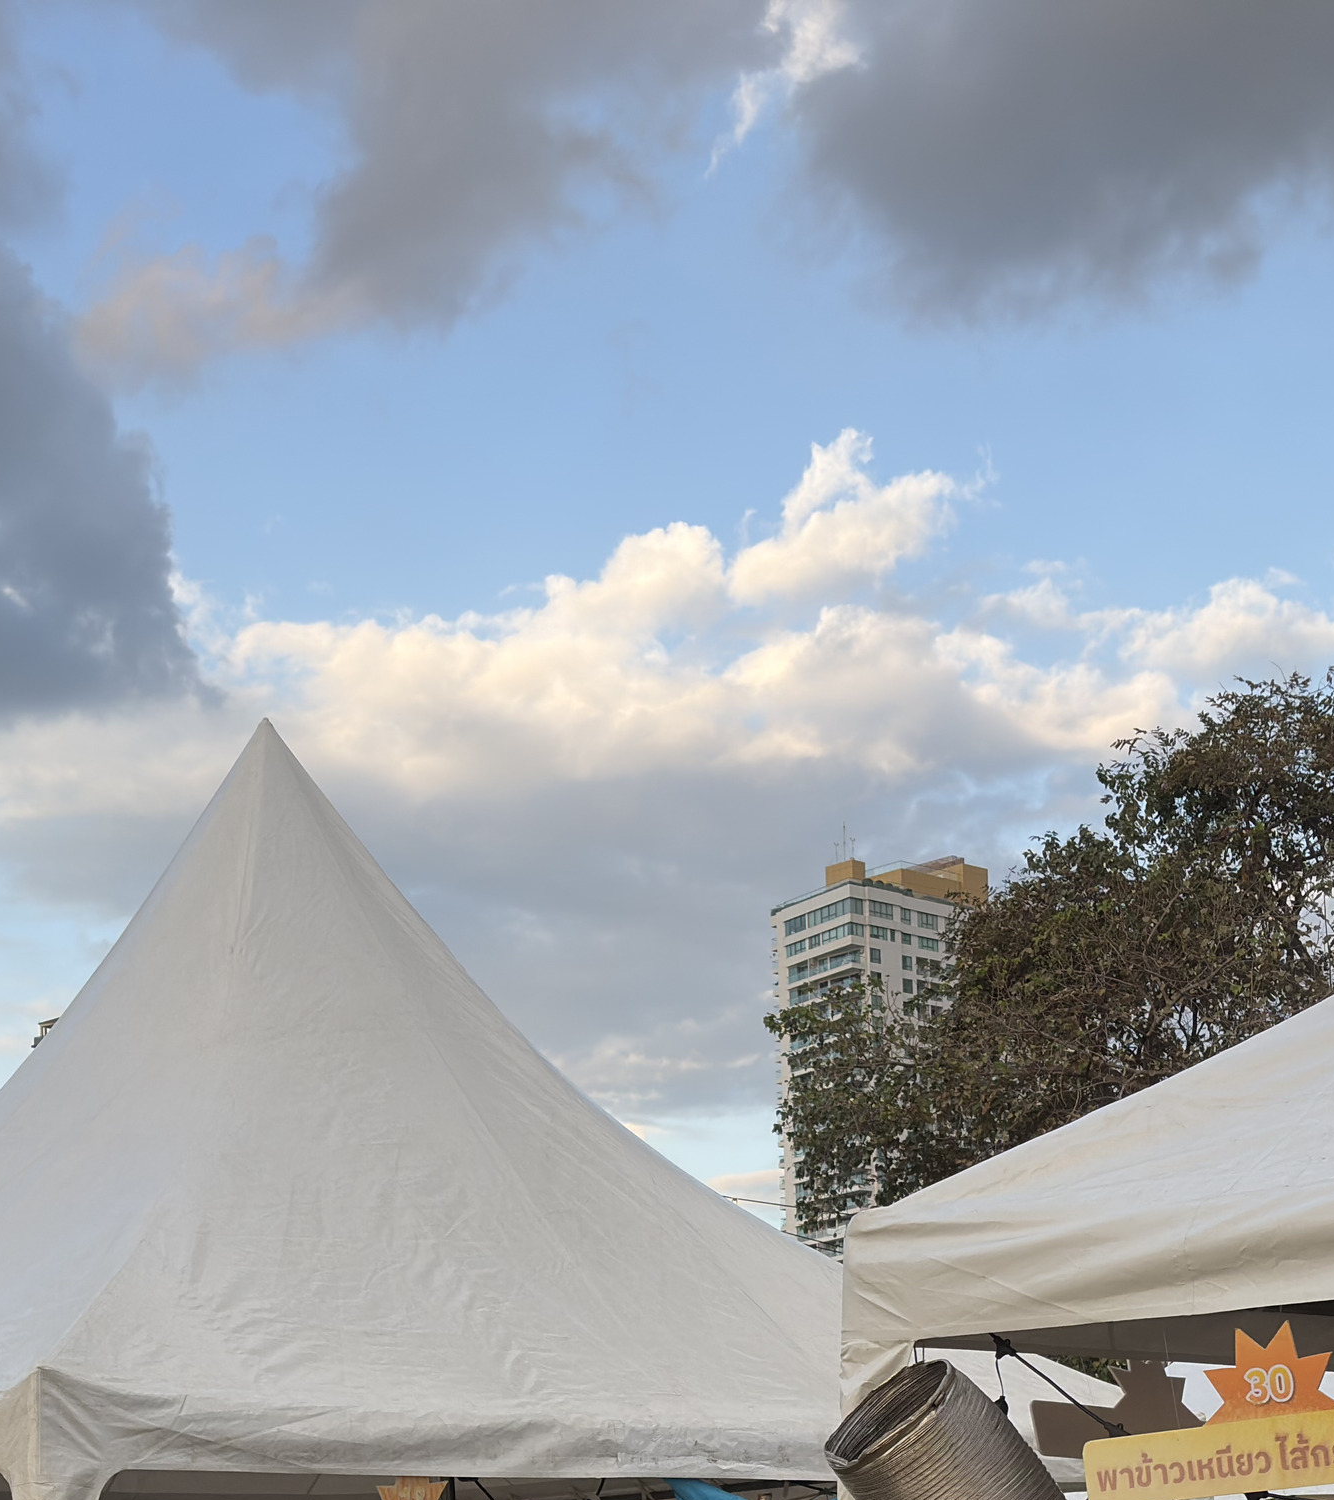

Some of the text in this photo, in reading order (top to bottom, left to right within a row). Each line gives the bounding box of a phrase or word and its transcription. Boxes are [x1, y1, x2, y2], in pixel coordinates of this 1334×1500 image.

[1244, 1364, 1294, 1406] 30
[1096, 1445, 1271, 1492] พาข้าวเหนียว
